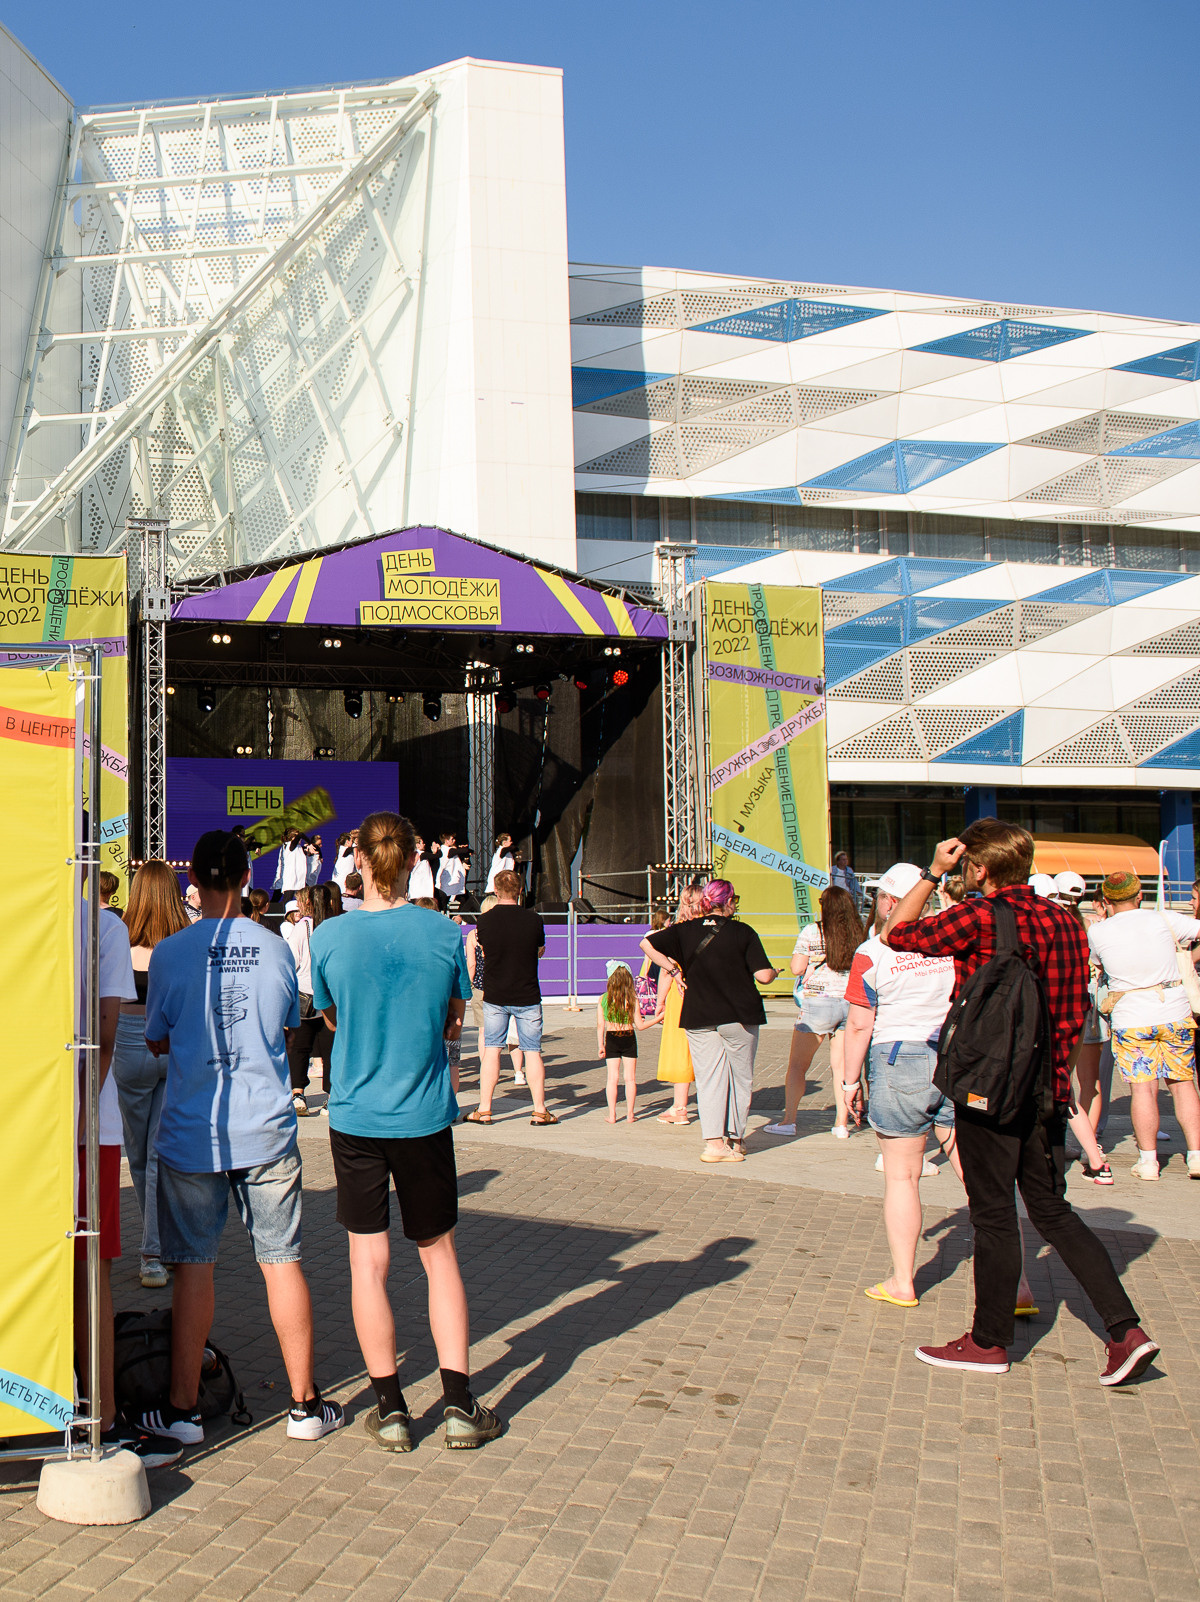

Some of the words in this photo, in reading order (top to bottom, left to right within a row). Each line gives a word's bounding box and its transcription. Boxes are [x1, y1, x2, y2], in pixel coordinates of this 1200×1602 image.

[386, 552, 432, 572] ДЕНЬ
[388, 579, 498, 598] МОЛОДЁЖИ
[48, 556, 70, 642] ПРОСВЕЩЕНИ
[712, 600, 756, 617] ДЕНЬ
[363, 605, 499, 623] ПОДМОСКОВЬЯ
[712, 618, 818, 637] МОЛОДЁЖИ
[751, 584, 773, 671] ПРОСВЕЩЕНИ
[713, 636, 750, 655] 2022
[5, 716, 16, 731] В
[20, 720, 75, 740] ЦЕНТРЕ
[711, 749, 759, 788] ДРУЖБА
[230, 789, 281, 812] ДЕНЬ
[740, 767, 775, 818] МУЗЫКА
[208, 946, 260, 959] STAFF
